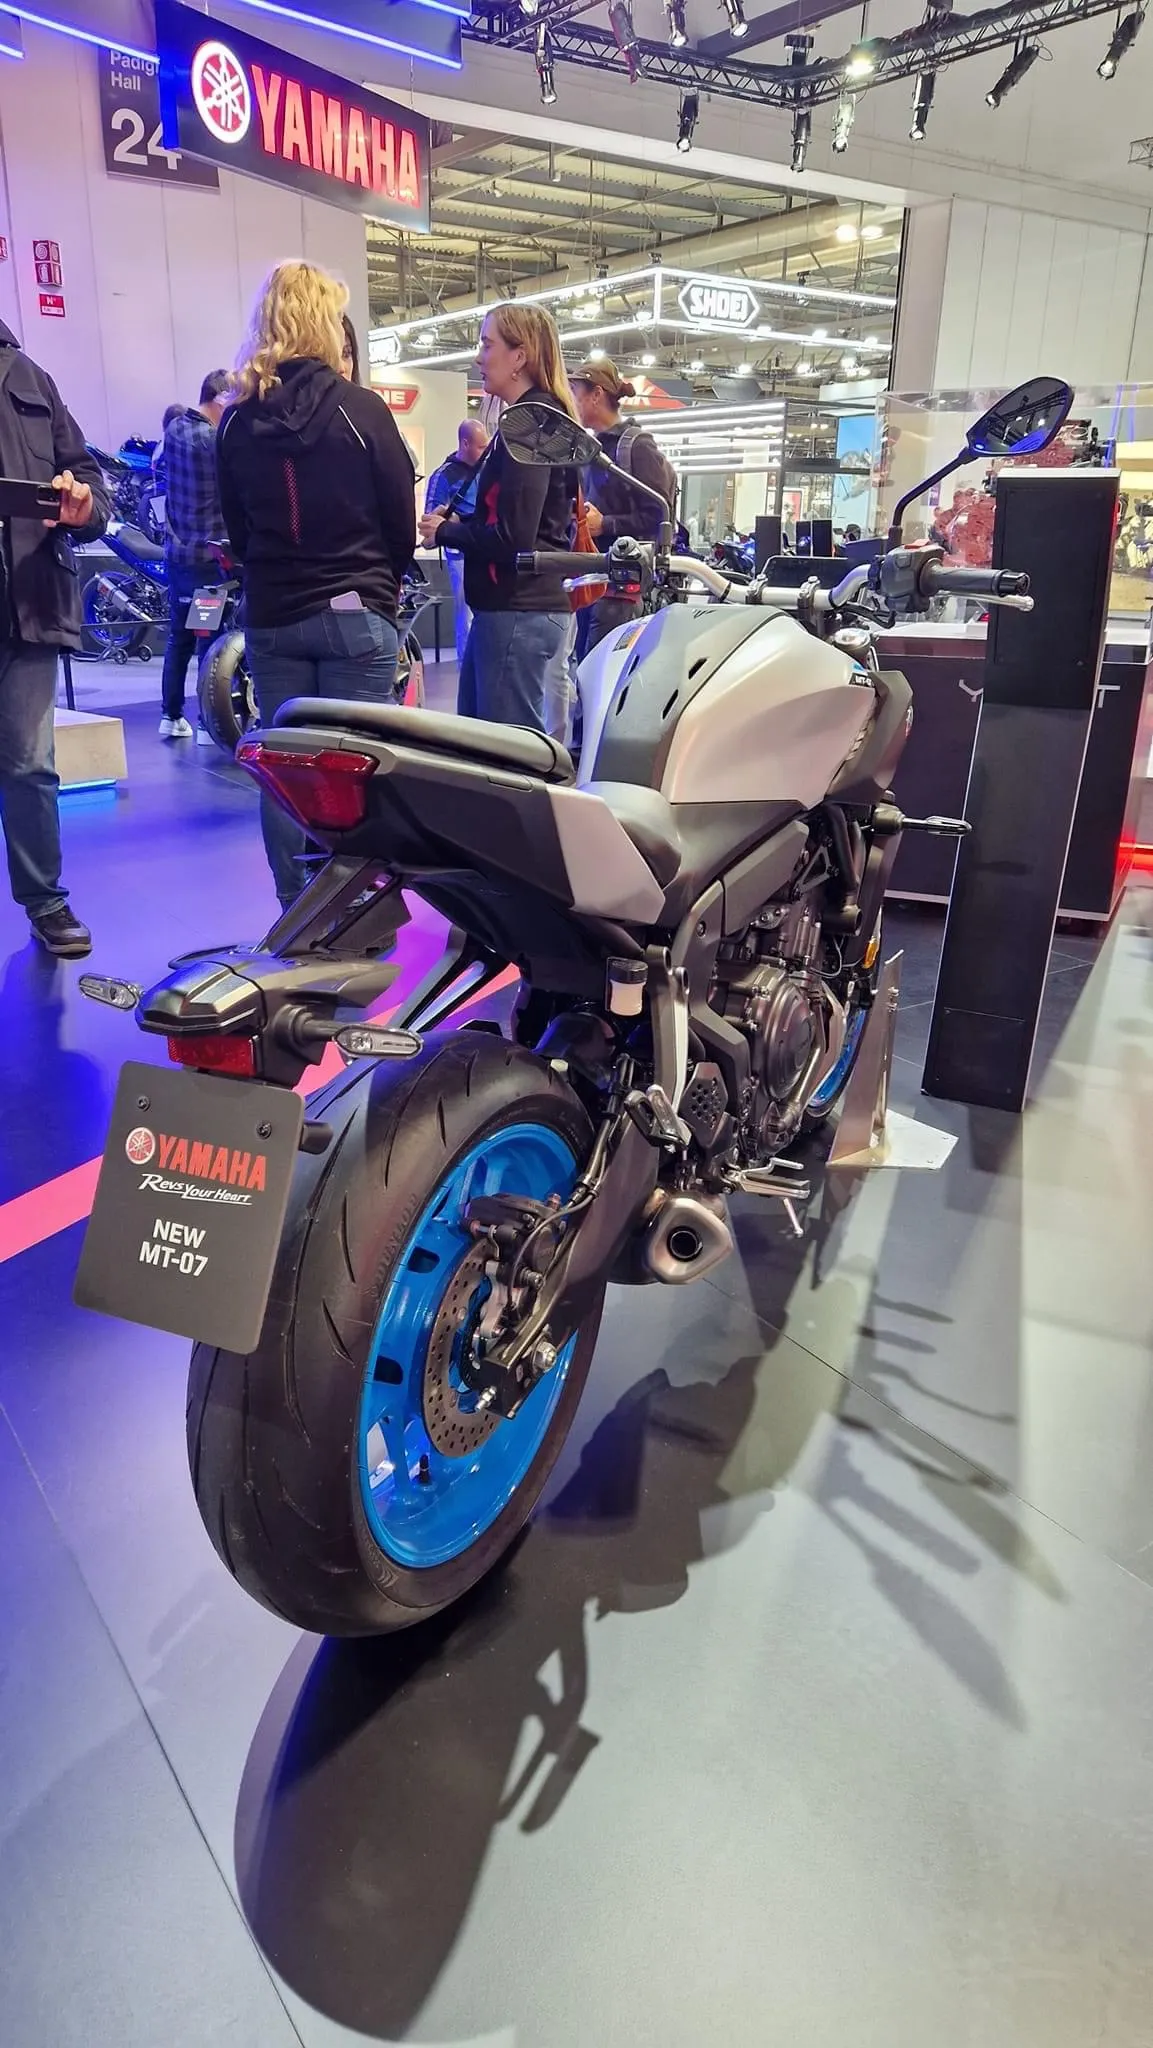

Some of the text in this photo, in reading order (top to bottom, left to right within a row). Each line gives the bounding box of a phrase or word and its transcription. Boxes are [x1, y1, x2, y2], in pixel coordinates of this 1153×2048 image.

[110, 49, 160, 76] Padigl
[111, 71, 141, 91] Hall
[111, 108, 182, 170] 24
[251, 64, 421, 209] YAMAHA
[690, 286, 749, 321] SHOEI
[159, 1134, 267, 1192] YAMAHA
[152, 1218, 206, 1249] NEW
[139, 1241, 208, 1277] MT-07
